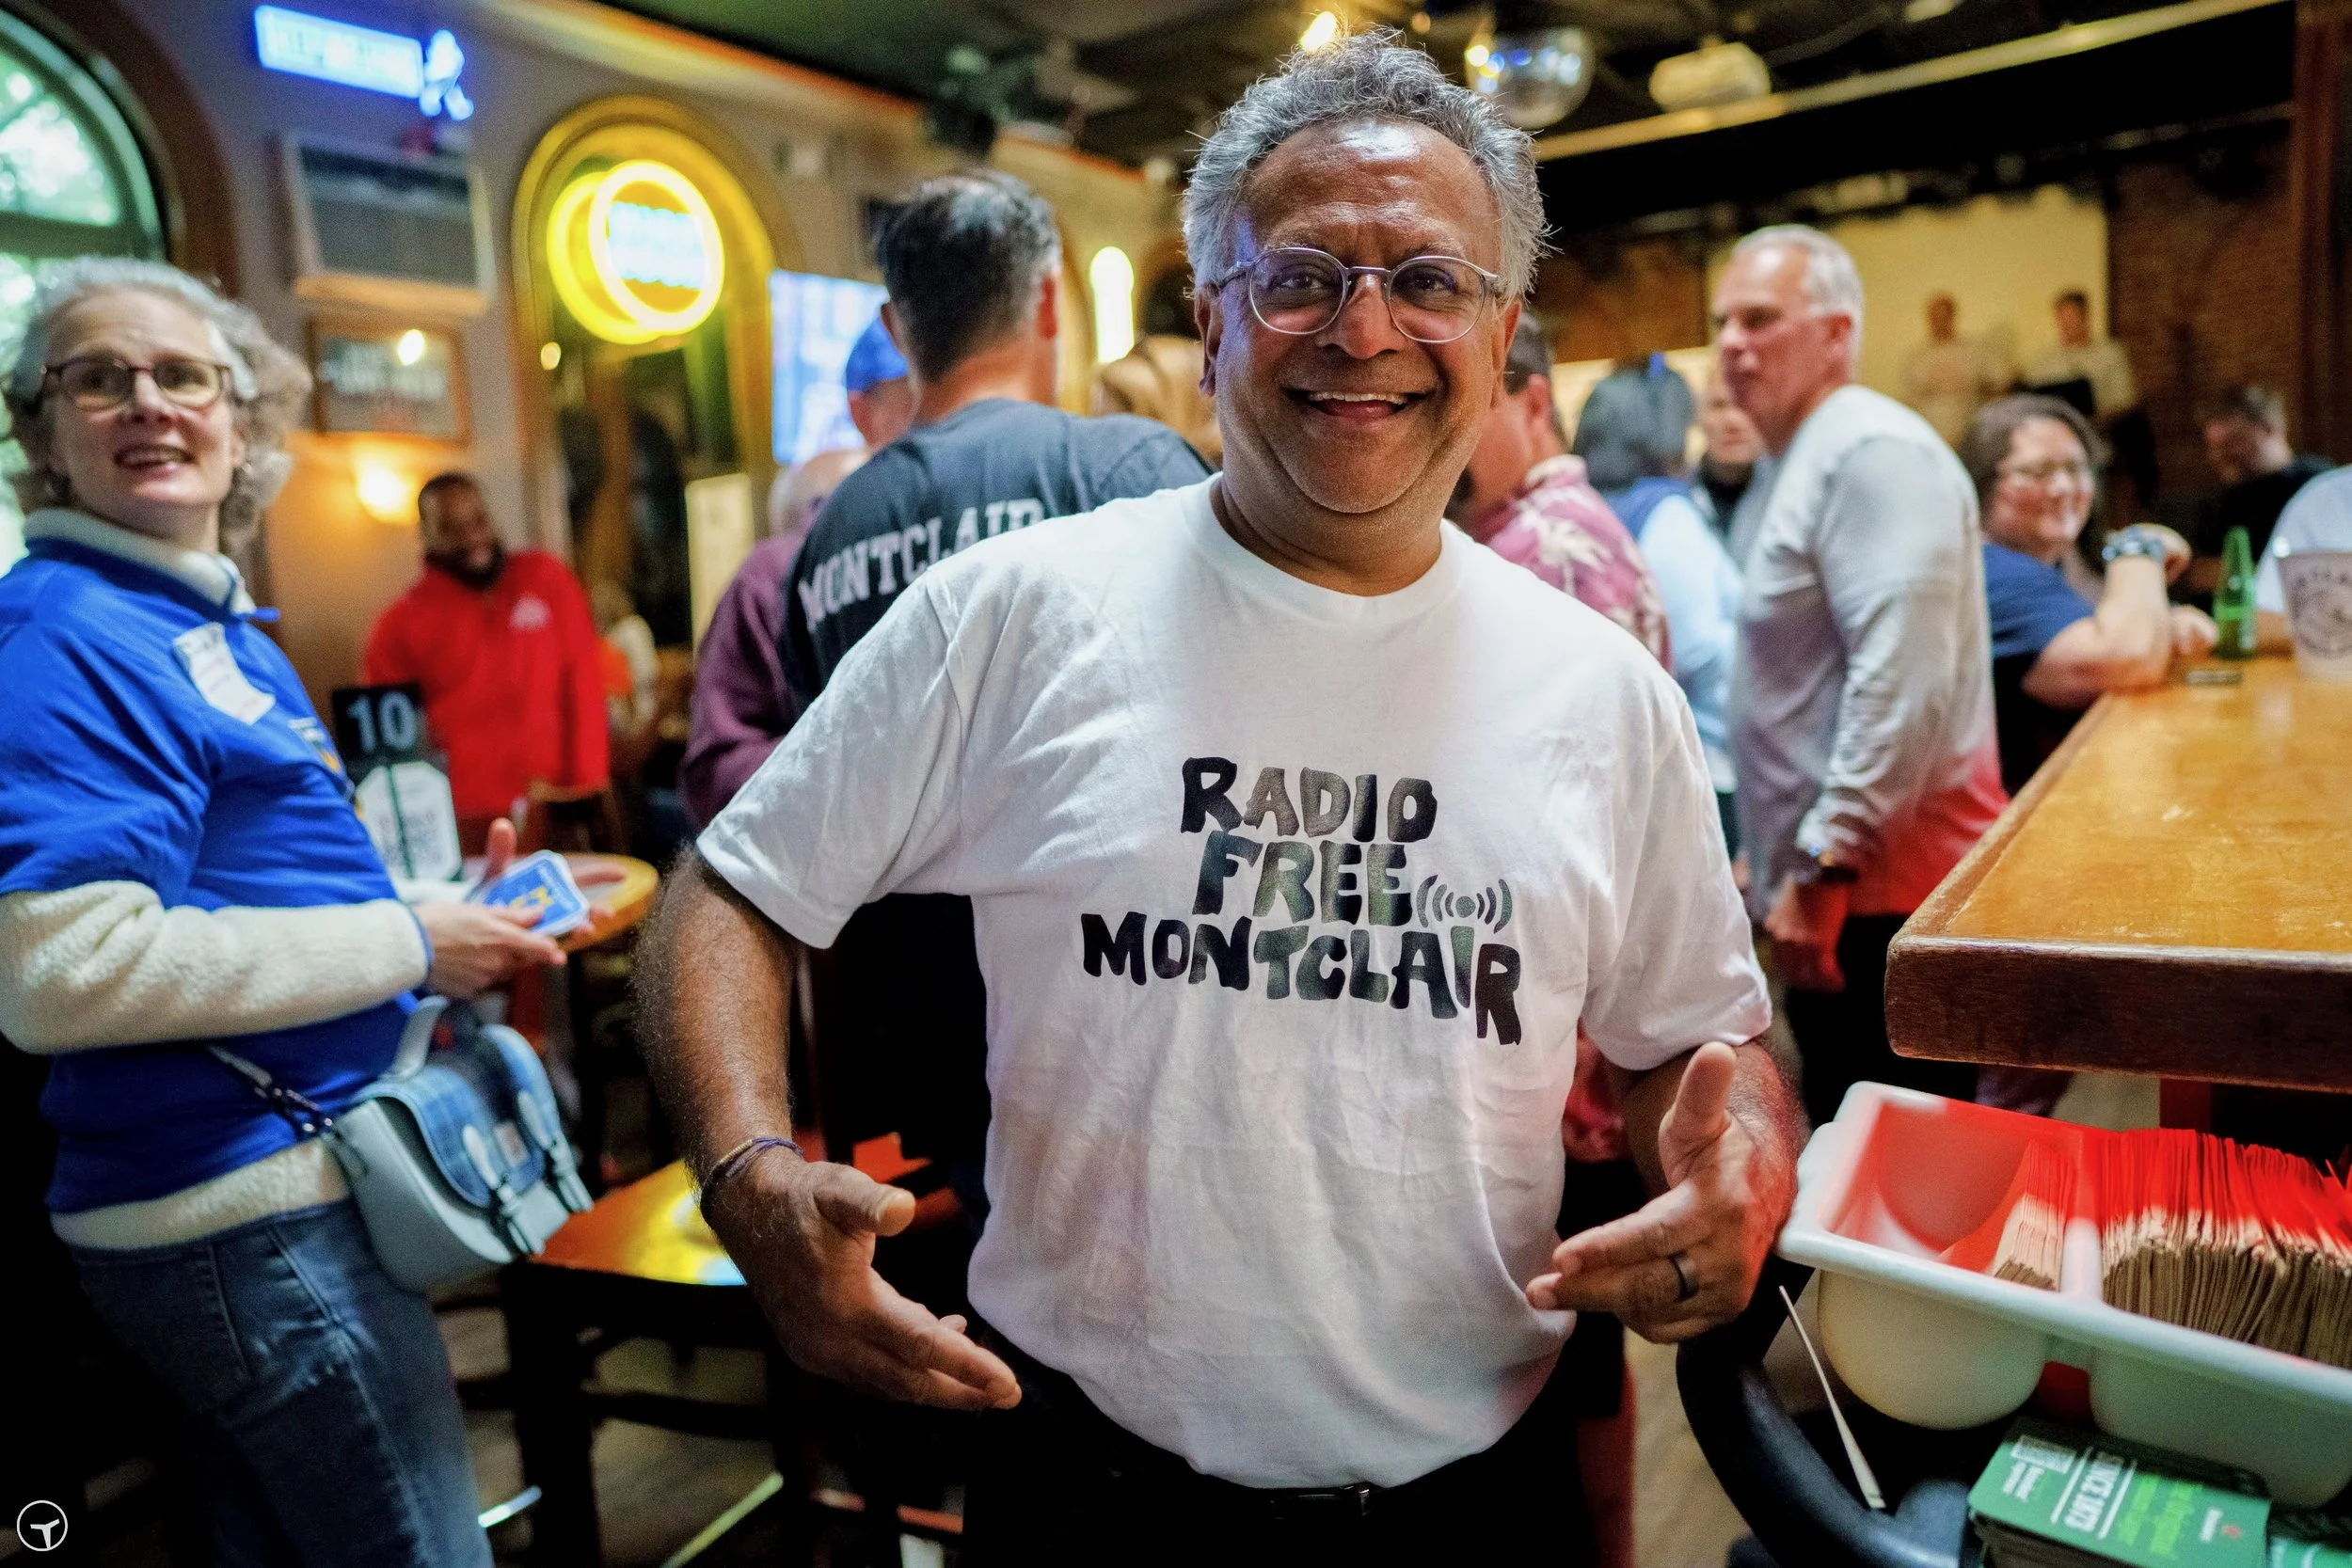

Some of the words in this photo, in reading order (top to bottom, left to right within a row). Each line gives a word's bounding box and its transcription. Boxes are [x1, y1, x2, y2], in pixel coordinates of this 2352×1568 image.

[346, 691, 417, 752] 10
[1181, 756, 1438, 843] RADIO
[1192, 830, 1413, 927] FREE
[1081, 911, 1522, 1046] MONTCLAIR
